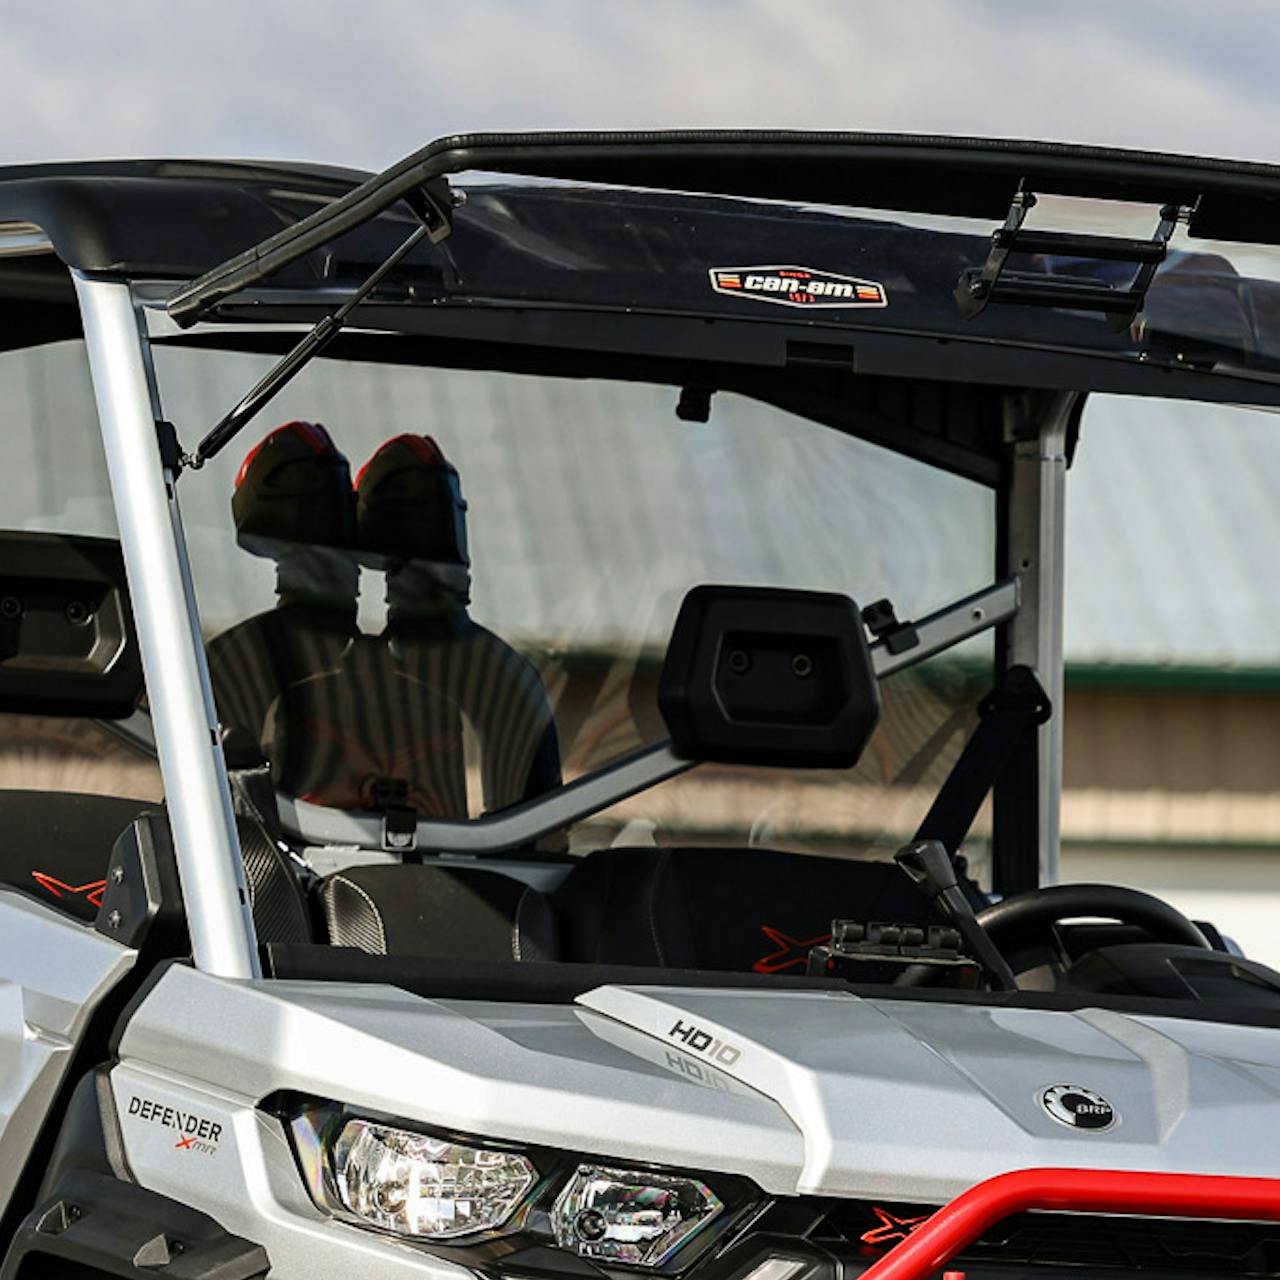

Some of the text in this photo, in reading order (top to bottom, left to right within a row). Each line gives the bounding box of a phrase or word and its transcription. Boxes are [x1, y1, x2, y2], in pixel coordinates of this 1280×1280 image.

[744, 275, 854, 298] can-am
[668, 1019, 743, 1067] HD10
[128, 1096, 222, 1142] DEFENDER
